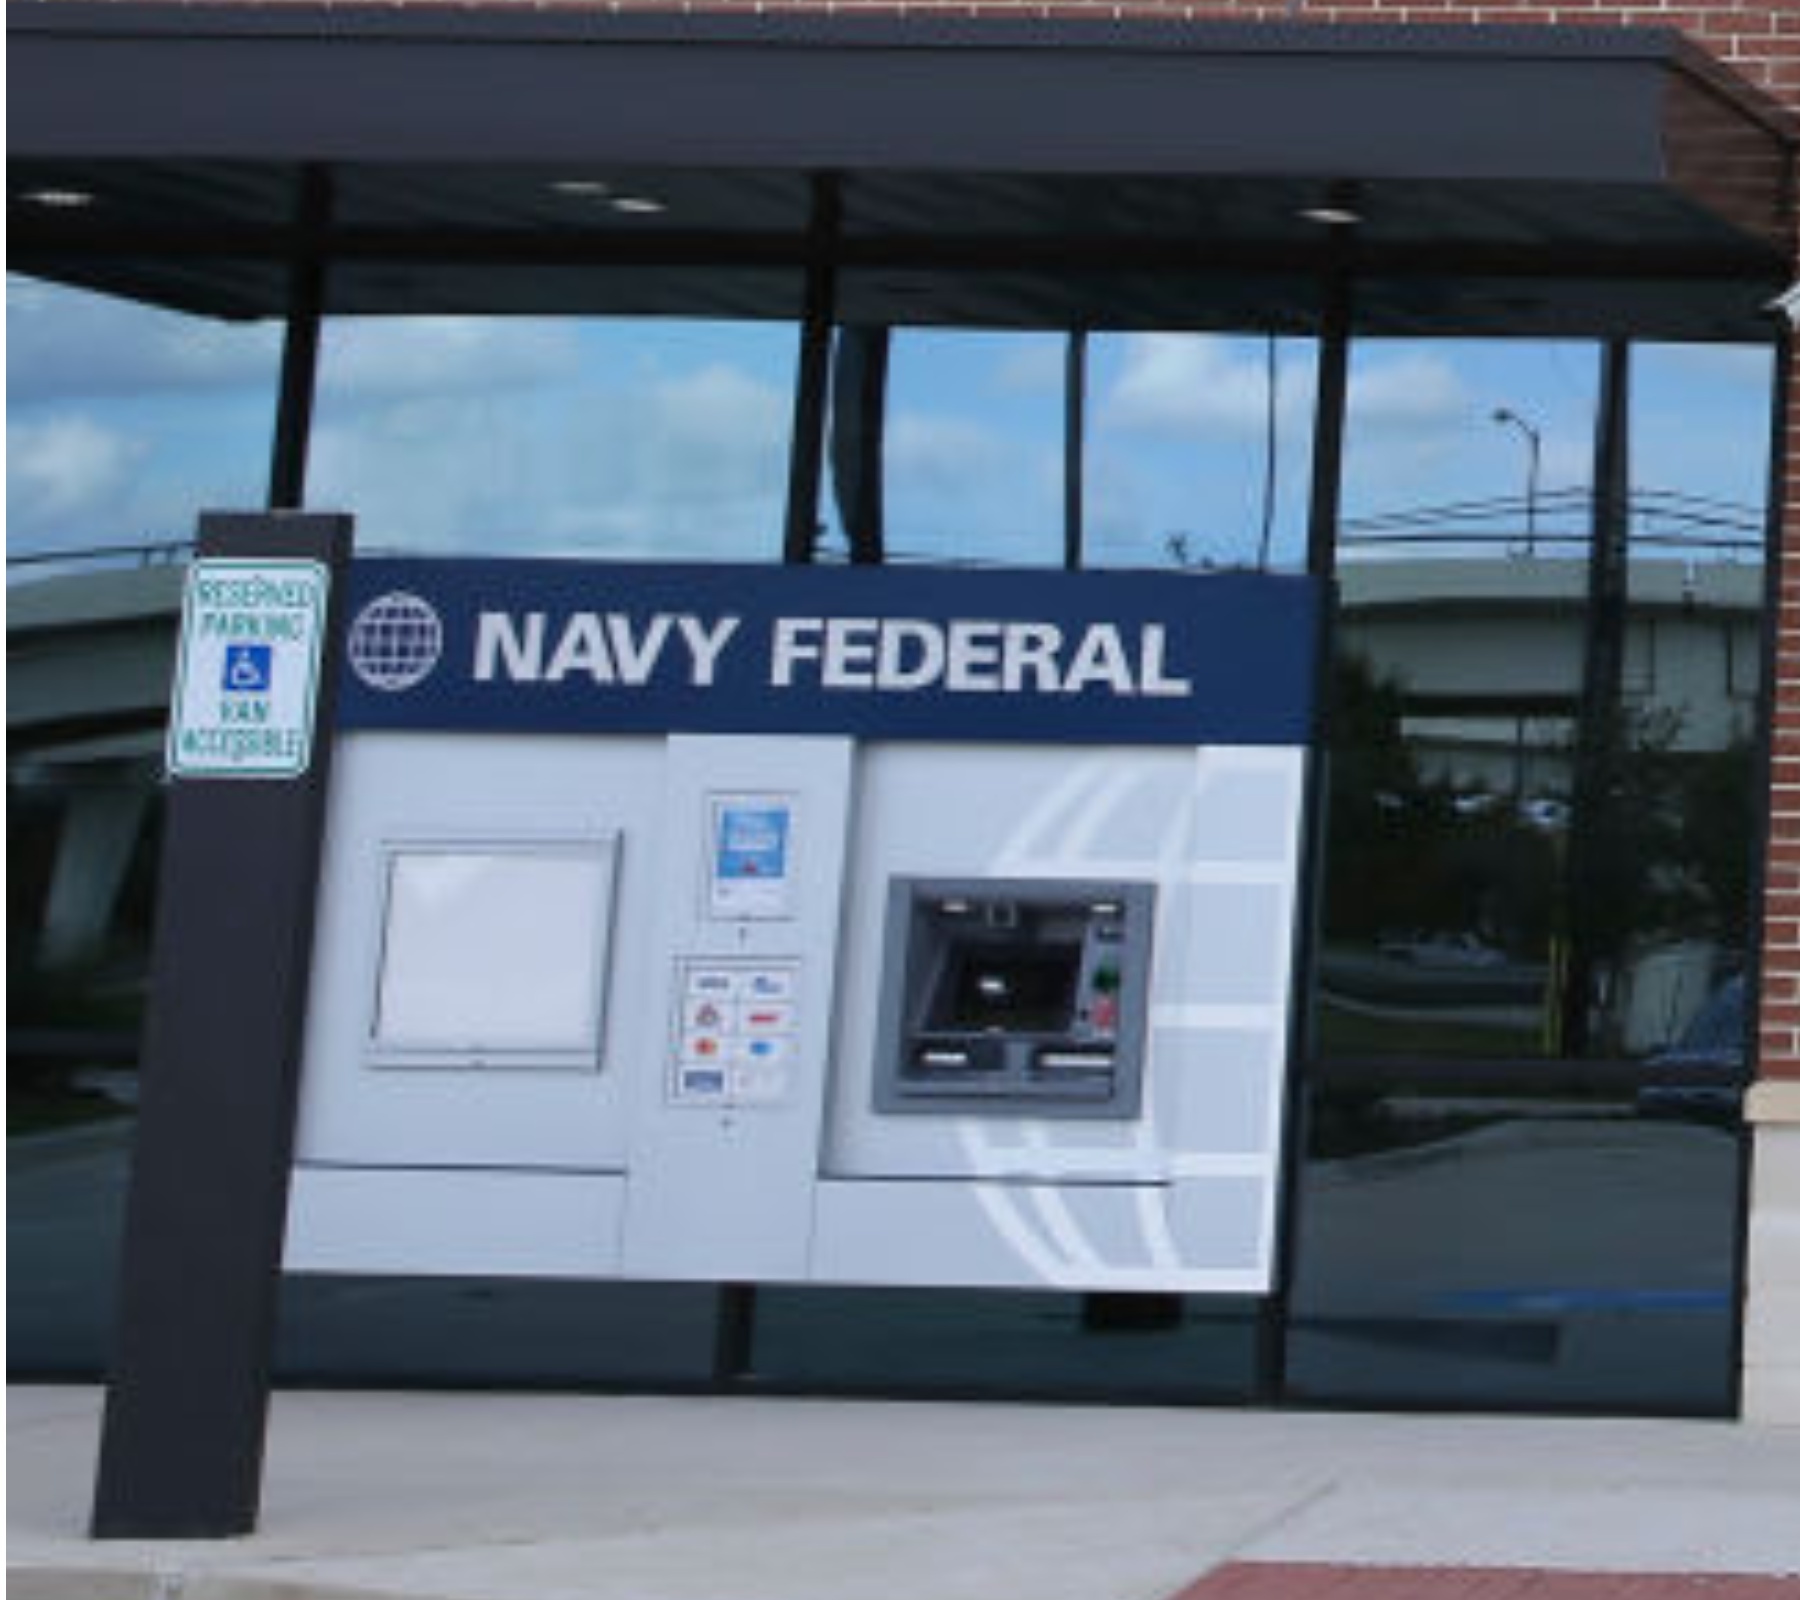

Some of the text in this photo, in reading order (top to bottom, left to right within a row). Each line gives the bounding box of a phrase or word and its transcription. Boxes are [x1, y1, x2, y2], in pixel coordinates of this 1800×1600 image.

[198, 577, 314, 607] RESERVED
[201, 612, 305, 640] PARKING
[472, 611, 1191, 697] NAVY FEDERAL
[219, 700, 271, 723] VAN
